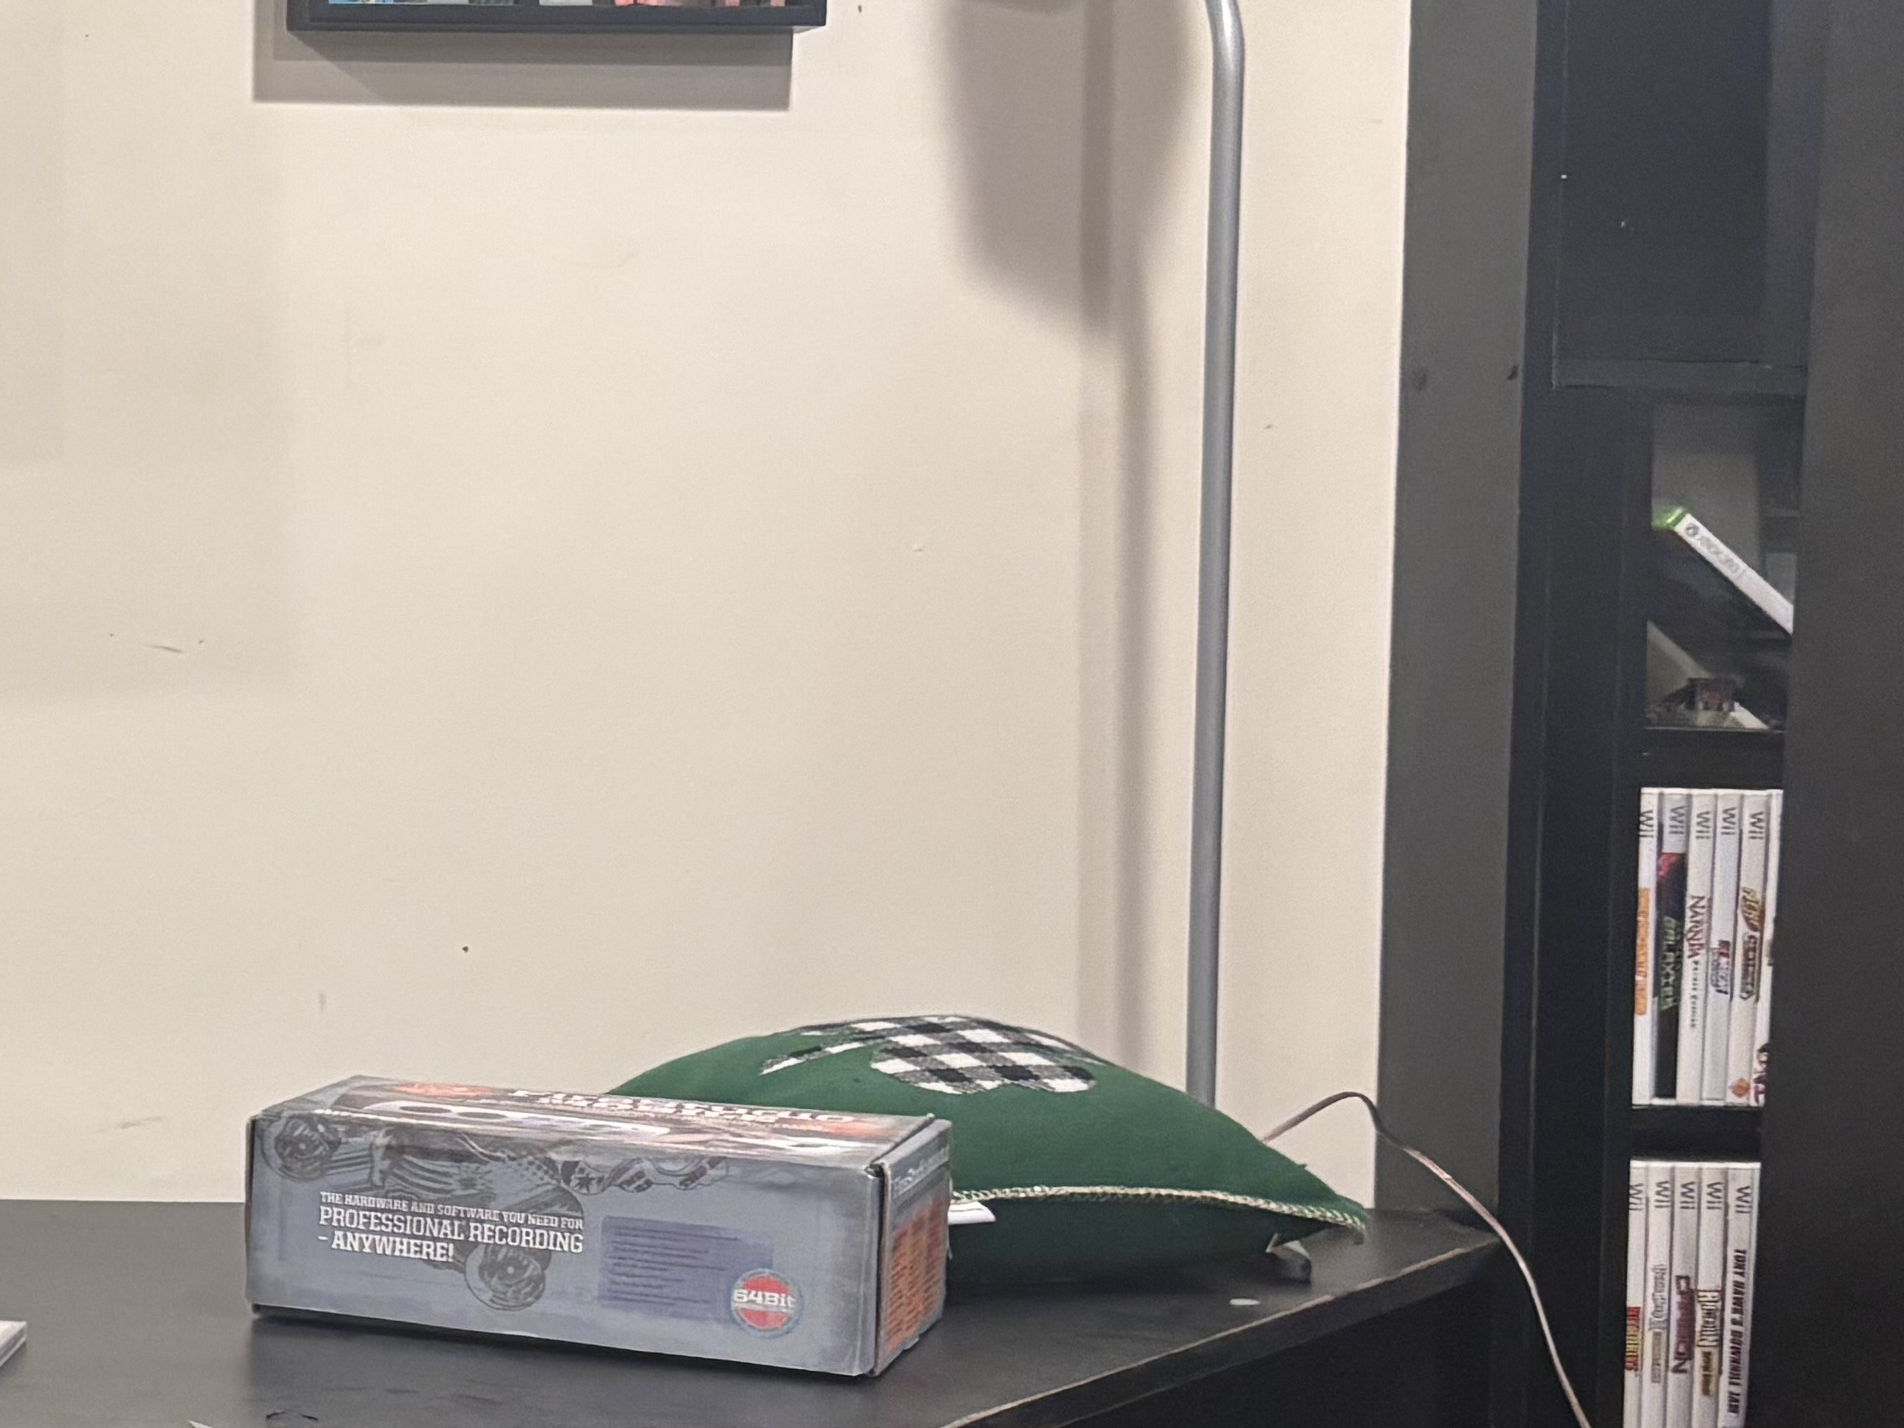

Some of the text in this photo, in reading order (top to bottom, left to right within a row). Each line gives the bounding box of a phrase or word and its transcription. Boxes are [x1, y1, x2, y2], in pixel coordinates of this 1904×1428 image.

[1639, 809, 1654, 839] Wii
[1669, 806, 1685, 836] Wii
[1696, 811, 1711, 840] Wii
[1721, 807, 1737, 836] Wii
[1749, 811, 1763, 840] Wii
[1686, 895, 1707, 959] NARNIA
[1629, 1183, 1644, 1211] Wii
[1654, 1181, 1670, 1209] Wii
[1680, 1181, 1695, 1209] Wii
[1707, 1182, 1722, 1210] Wii
[1736, 1185, 1752, 1214] Wii
[320, 1191, 583, 1230] THE HARDWARE AND SOFTWARE YOU NEED FOR
[319, 1206, 583, 1253] PROFESSIONAL RECORDING
[330, 1234, 454, 1262] ANYWHERE!
[733, 1288, 796, 1309] 64Bit
[1727, 1249, 1747, 1414] TONY HAWK'S DOWNHILL JAM
